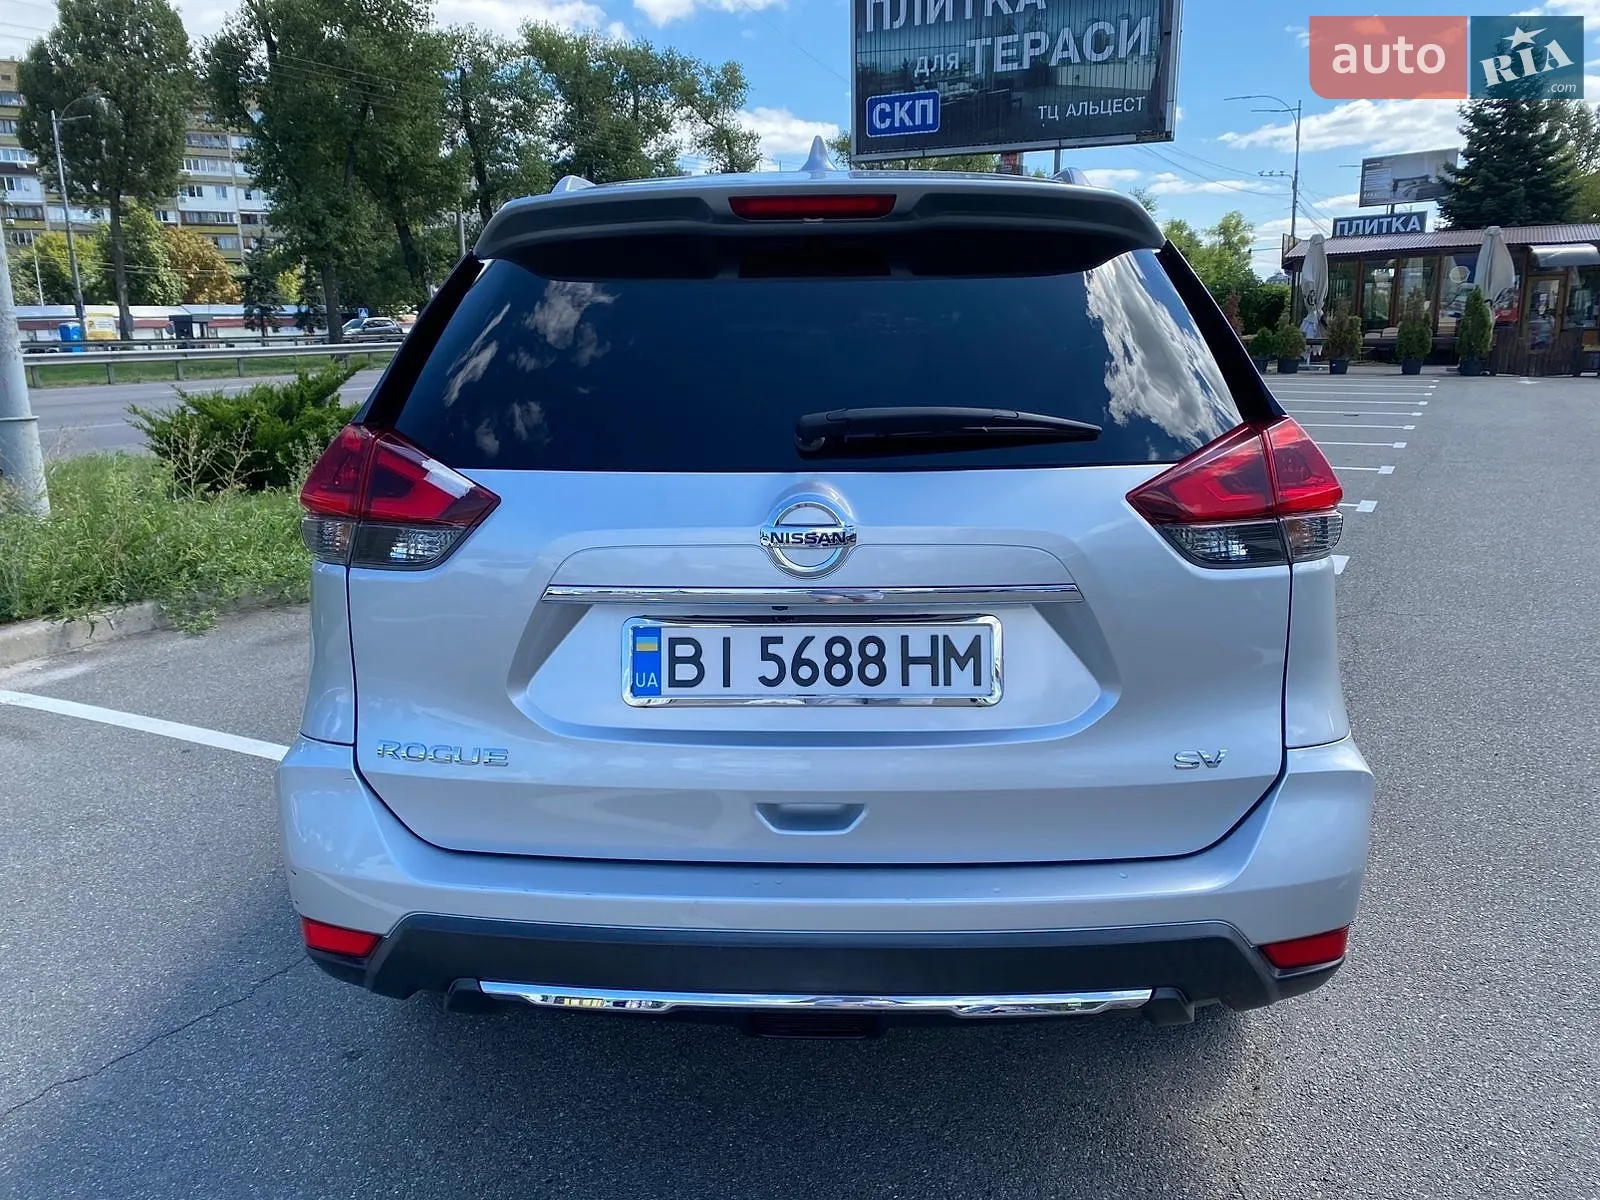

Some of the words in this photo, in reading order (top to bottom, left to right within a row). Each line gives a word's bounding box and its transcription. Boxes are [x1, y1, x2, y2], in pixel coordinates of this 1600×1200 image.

[966, 16, 1151, 74] ТЕРАСИ
[872, 98, 934, 130] СКП
[1038, 104, 1059, 121] ТЦ
[1065, 96, 1146, 118] АЛЬЦЕСТ
[1336, 215, 1421, 236] ПЛИТКА
[770, 531, 847, 544] NISSAN
[667, 636, 731, 688] BI
[757, 635, 888, 687] 5688
[900, 634, 982, 687] HM
[635, 672, 659, 689] UA
[377, 740, 510, 767] ROGUE
[1174, 749, 1228, 770] SV
